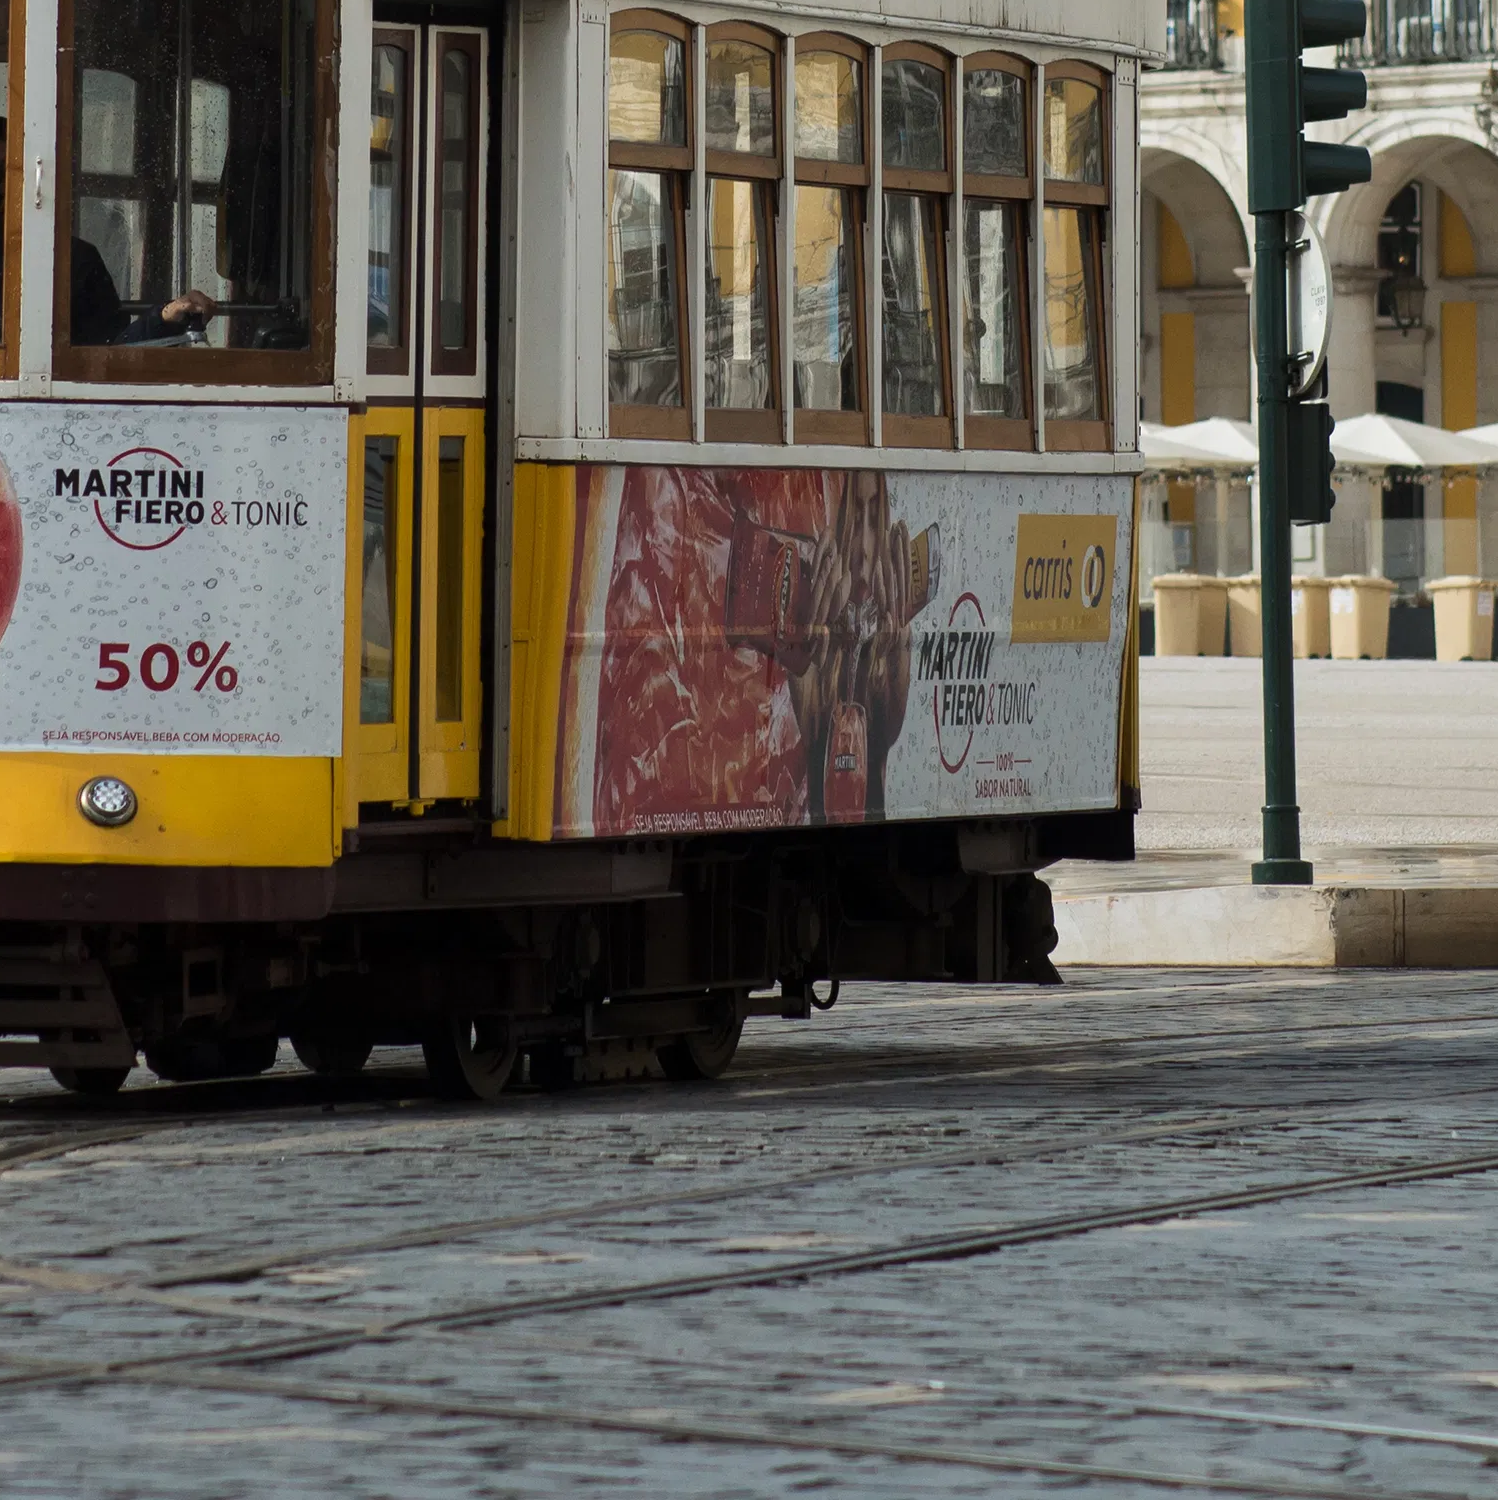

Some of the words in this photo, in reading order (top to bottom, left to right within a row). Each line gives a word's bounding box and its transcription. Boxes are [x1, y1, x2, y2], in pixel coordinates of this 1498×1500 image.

[55, 468, 204, 498] MARTINI
[115, 500, 205, 525] FIERO
[1023, 539, 1073, 600] carris
[95, 640, 238, 693] 50%
[917, 631, 995, 681] MARTINI
[942, 684, 986, 727] FIERO
[42, 730, 69, 741] SEJA
[183, 732, 210, 743] COM
[212, 731, 283, 744] MODERAÇÃO.
[995, 753, 1014, 771] 100%
[975, 779, 998, 798] SABOR
[999, 778, 1032, 797] NATURAL
[634, 814, 653, 833] SEJA
[704, 811, 723, 830] BEBA
[723, 810, 739, 829] COM
